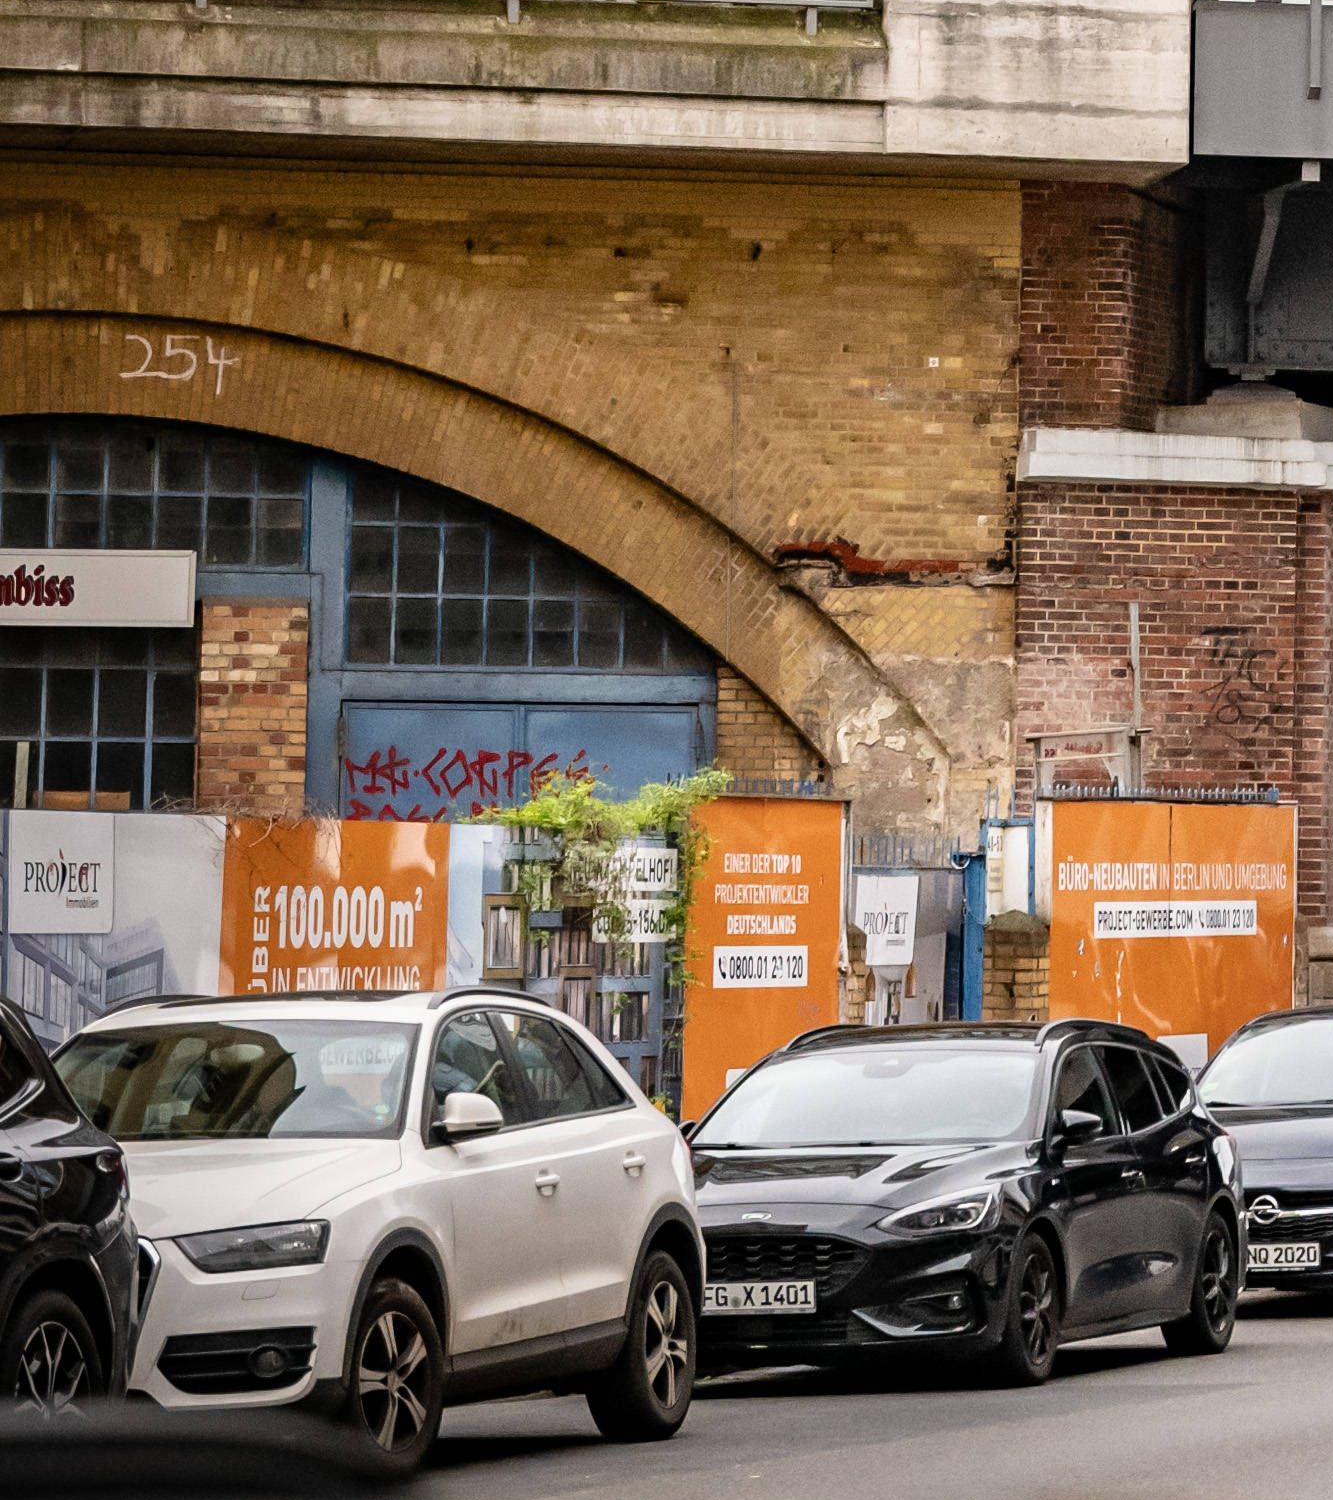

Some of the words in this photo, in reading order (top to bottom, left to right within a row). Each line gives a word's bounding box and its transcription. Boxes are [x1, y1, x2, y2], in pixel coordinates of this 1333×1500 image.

[119, 334, 240, 396] 254
[723, 852, 750, 874] EINER
[752, 853, 770, 874] DER
[771, 854, 790, 874] TOP
[791, 854, 802, 874] 10
[1058, 855, 1158, 891] BÜRO-NEUBAUTEN
[1159, 863, 1170, 891] IN
[1173, 863, 1210, 891] BERLIN
[1212, 863, 1232, 890] UND
[1234, 863, 1287, 890] UMGEBUNG
[23, 858, 101, 896] PROJECT
[714, 884, 809, 905] PROJEKTENTWICKLER
[274, 885, 385, 949] 100.000
[726, 914, 797, 935] DEUTSCHLANDS
[1098, 909, 1193, 931] PROJECT-GEWERBE.COM
[1206, 909, 1231, 929] 0800.01
[1232, 909, 1241, 928] 23
[1242, 908, 1254, 928] 120
[729, 955, 768, 980] 0800.01
[786, 955, 803, 979] 120
[272, 967, 291, 993] IN
[1247, 1247, 1269, 1264] NQ
[1273, 1246, 1317, 1264] 2020
[743, 1285, 755, 1306] X
[760, 1284, 812, 1306] 1401
